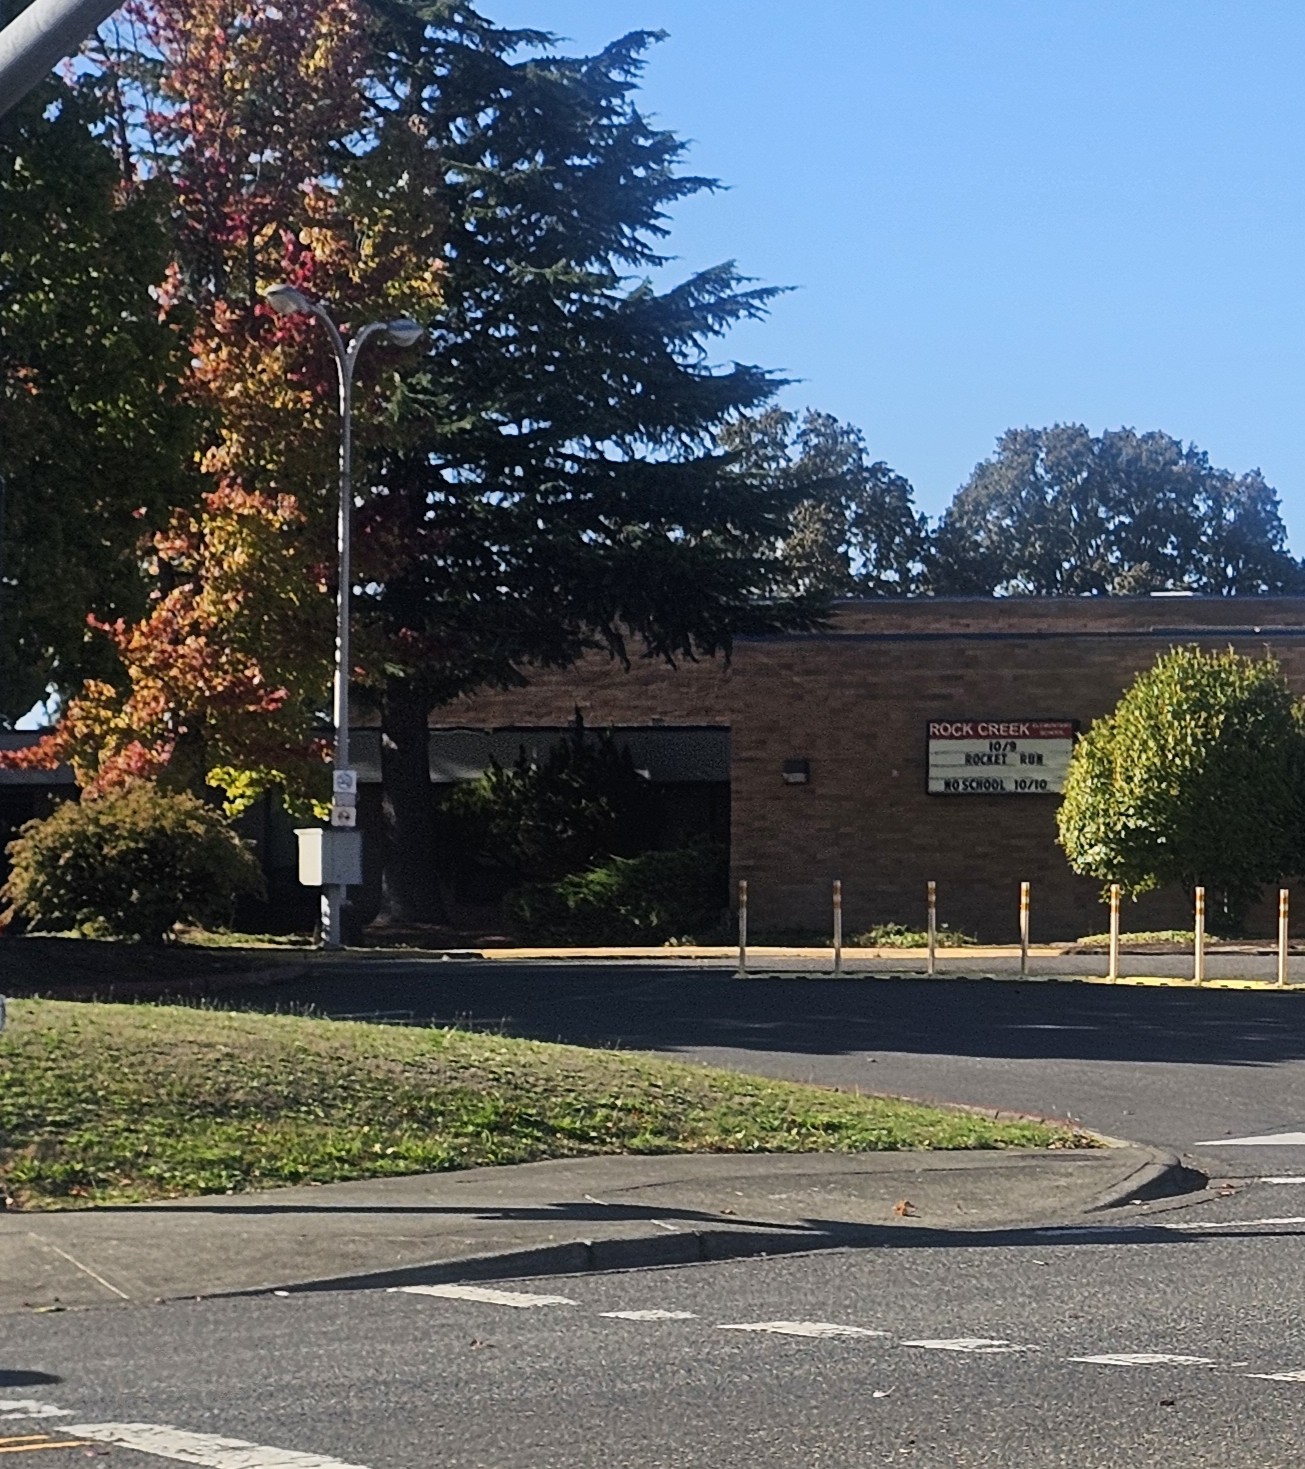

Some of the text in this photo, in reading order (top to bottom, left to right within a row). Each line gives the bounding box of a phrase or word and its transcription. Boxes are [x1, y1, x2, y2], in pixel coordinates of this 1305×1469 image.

[930, 722, 1030, 736] ROCK CREEK
[989, 741, 1017, 752] 10/9
[965, 754, 1043, 765] ROCKET RUN
[944, 779, 1047, 791] NO SCHOOL 10/10
